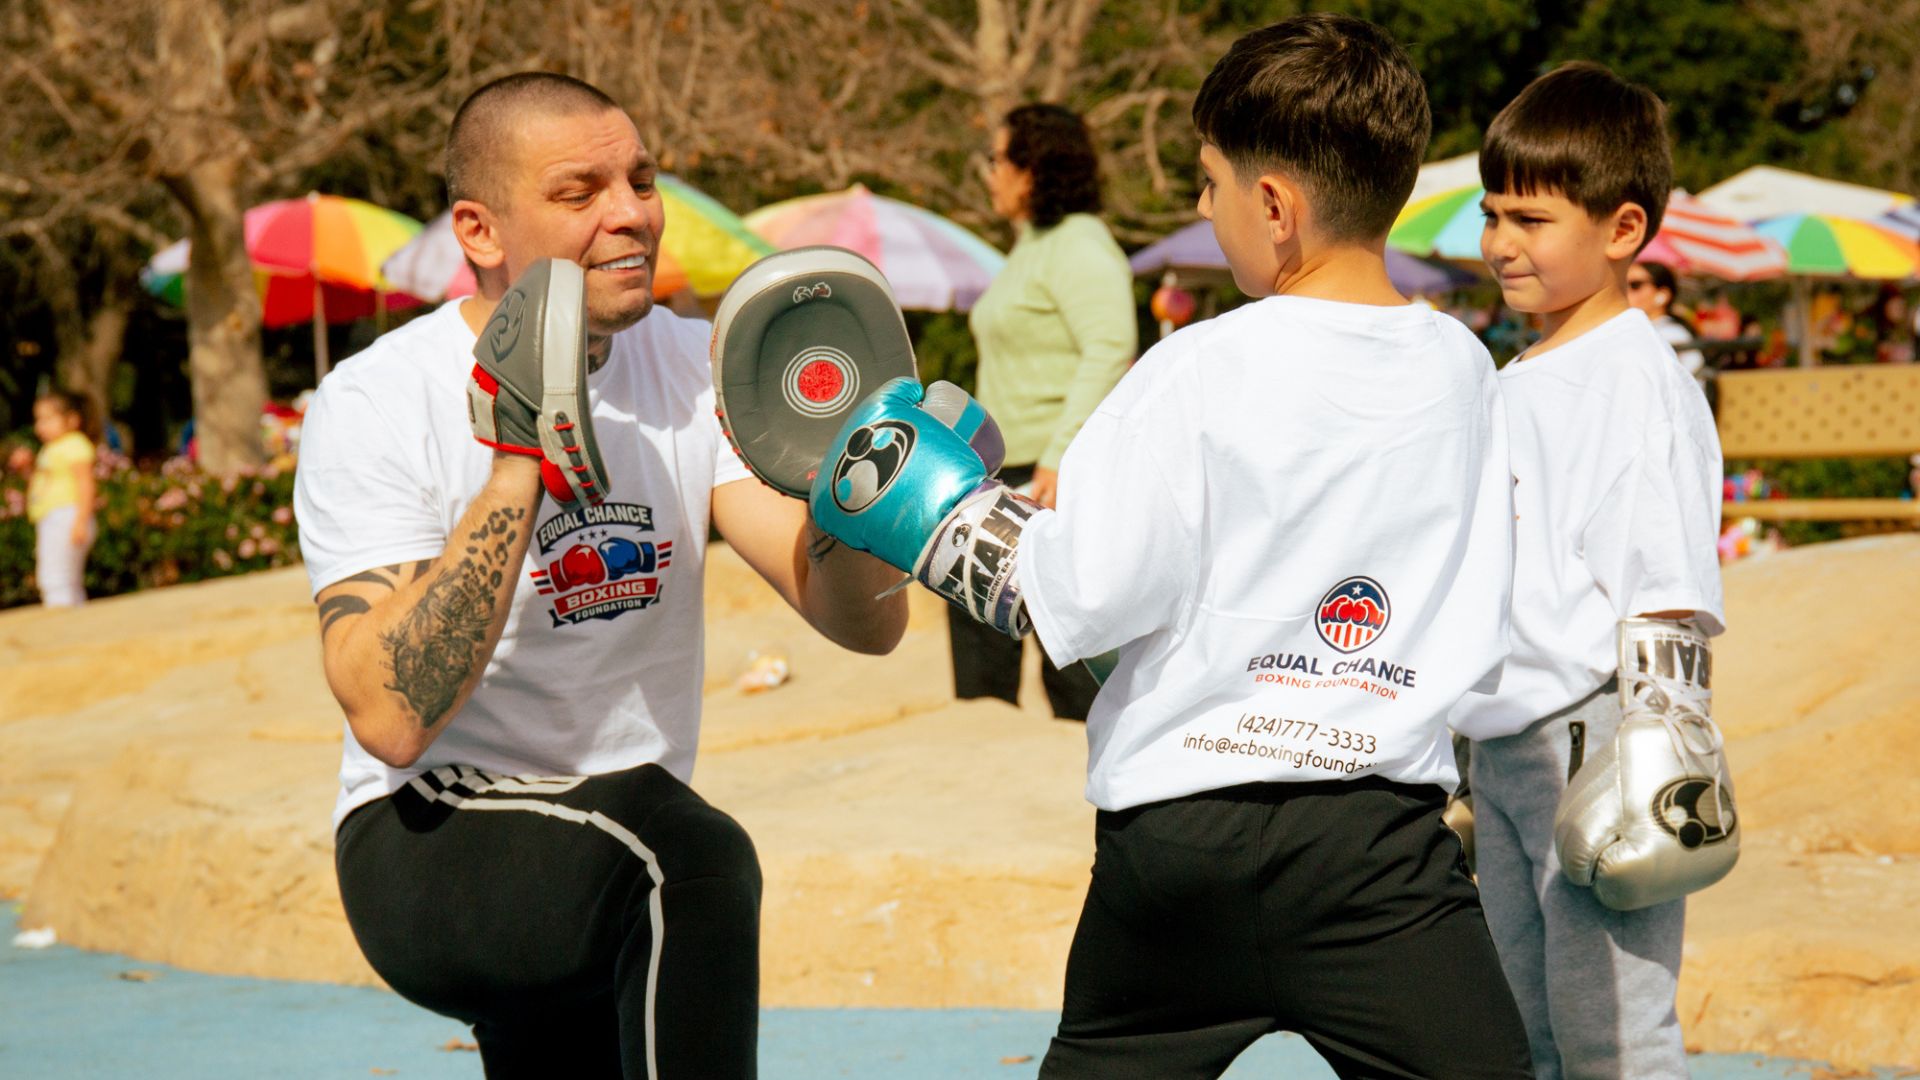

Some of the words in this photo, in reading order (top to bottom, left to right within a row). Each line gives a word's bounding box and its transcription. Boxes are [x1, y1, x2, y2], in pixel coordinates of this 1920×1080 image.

[541, 512, 583, 547] EQUAL
[584, 505, 650, 524] CHANCE
[566, 581, 646, 608] BOXING
[988, 574, 1003, 602] HECHO
[1001, 562, 1010, 573] EN
[576, 600, 641, 620] FOUNDATION
[1247, 653, 1323, 676] EQUAL
[1332, 657, 1416, 688] CHANCE
[1255, 674, 1311, 689] BOXING
[1315, 678, 1398, 700] FOUNDATION
[1237, 713, 1376, 754] (424)777-3333
